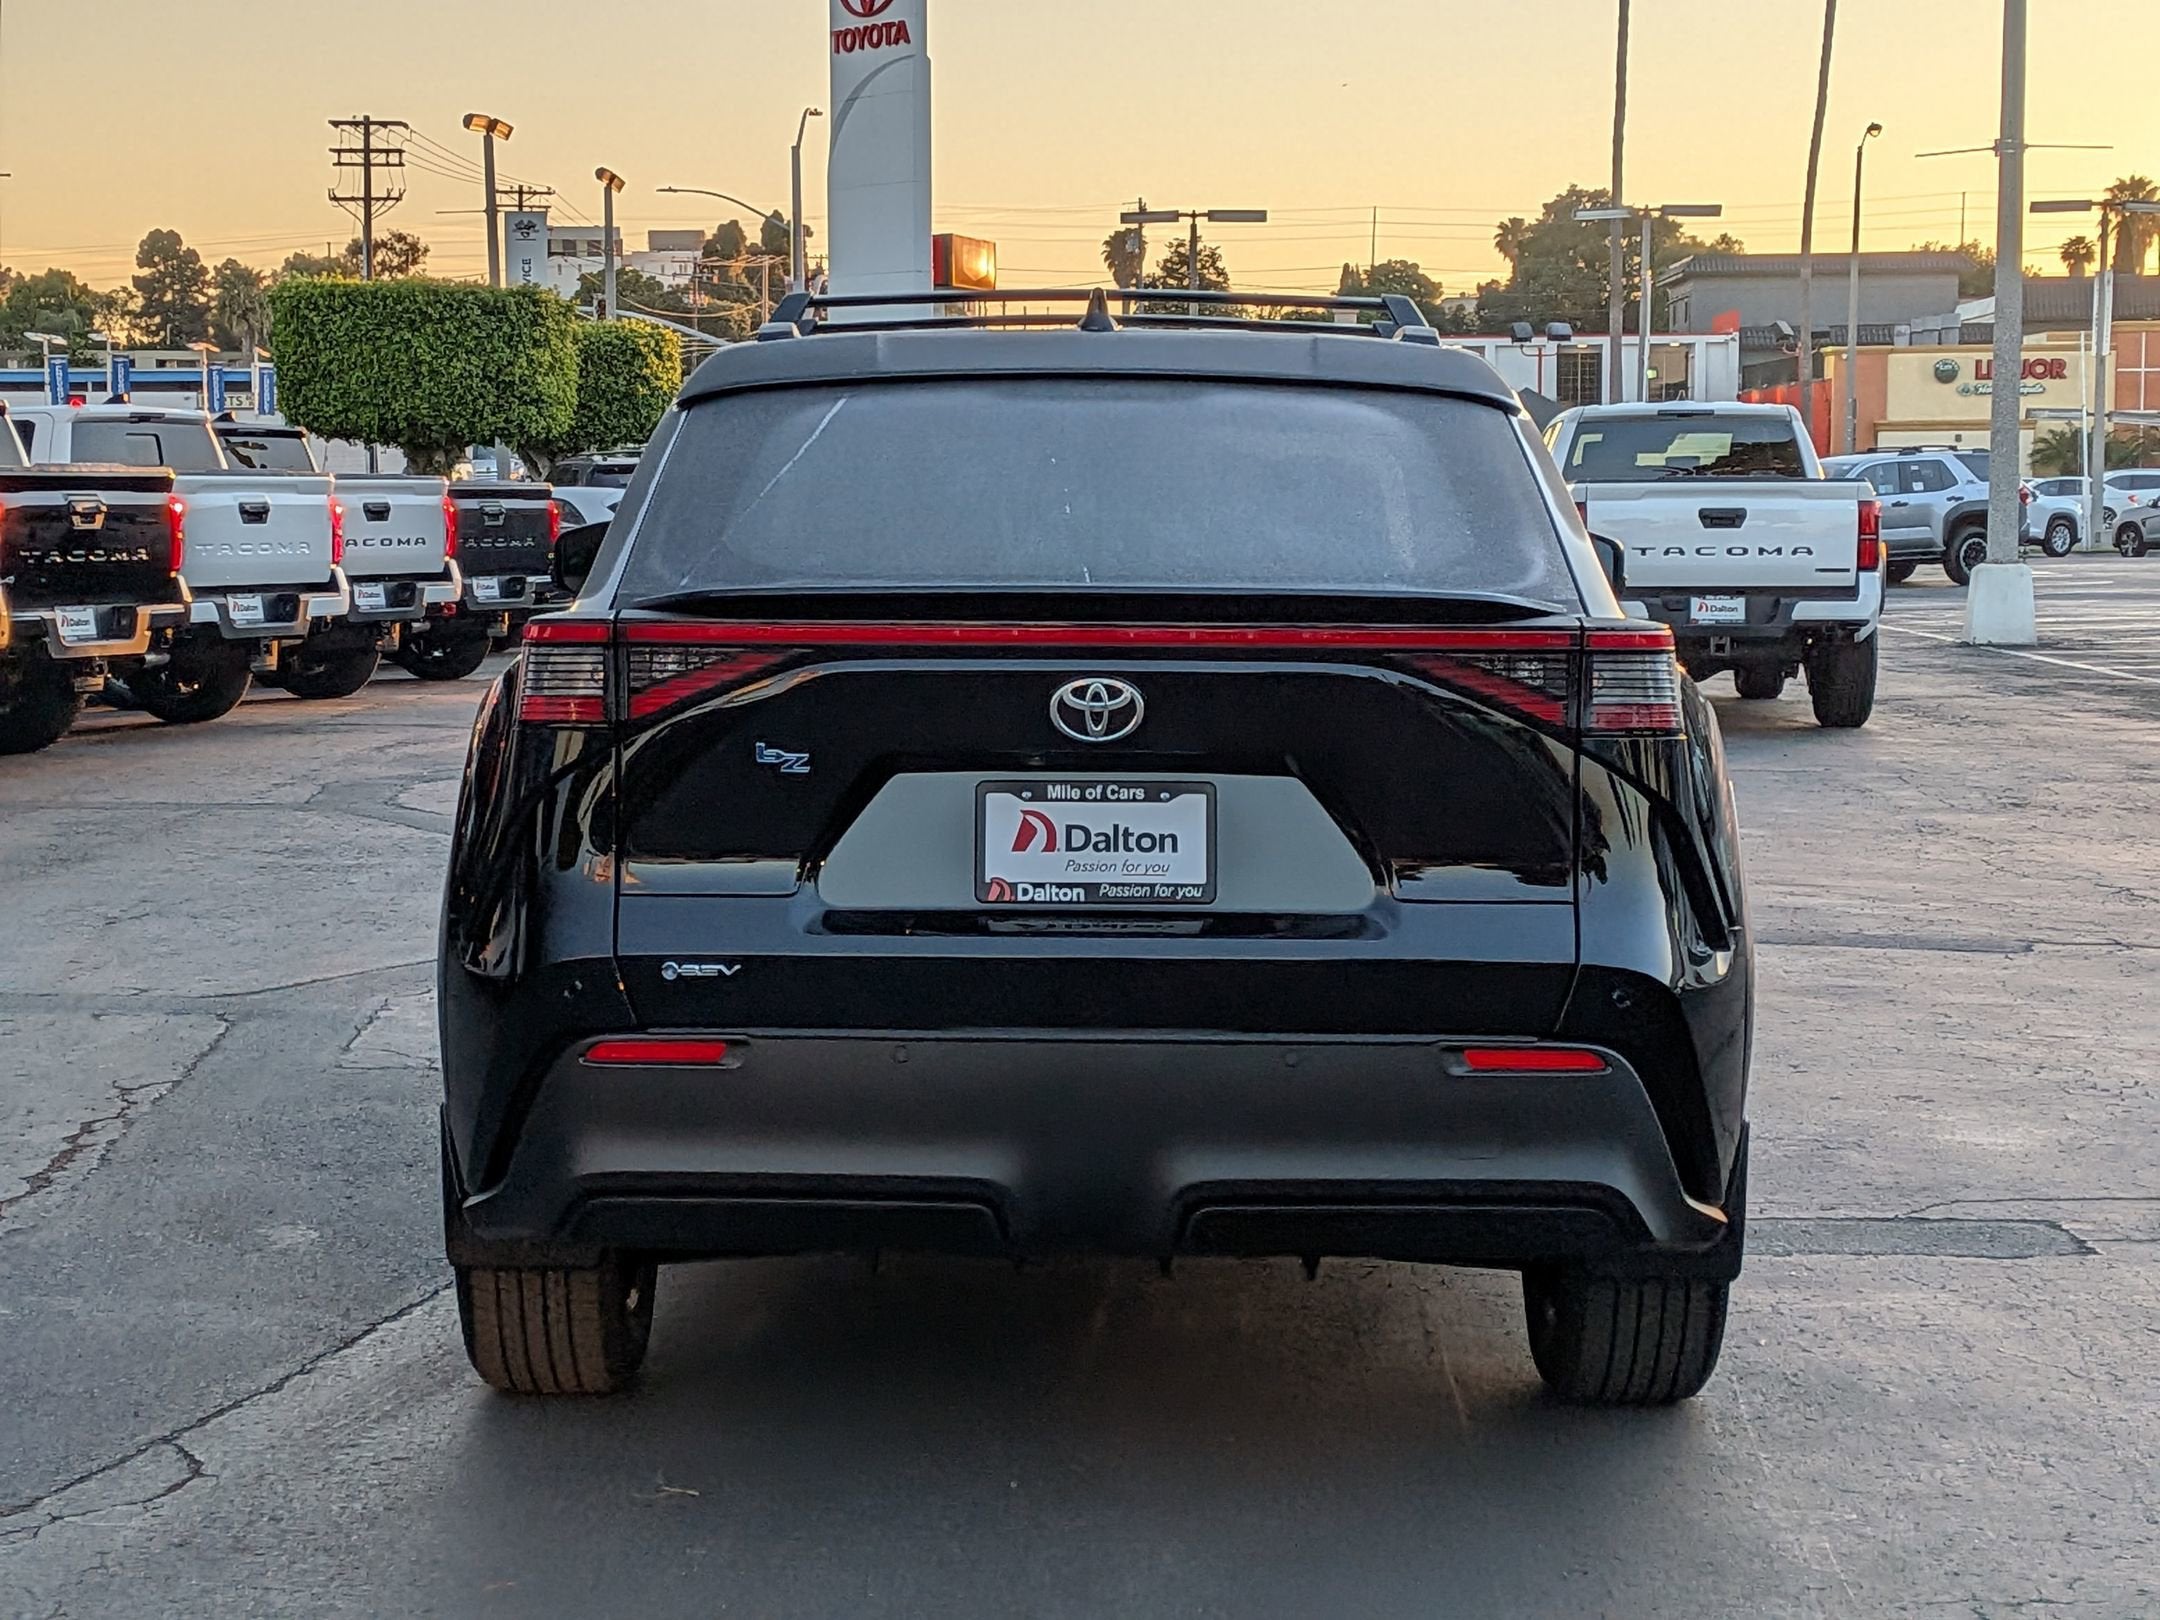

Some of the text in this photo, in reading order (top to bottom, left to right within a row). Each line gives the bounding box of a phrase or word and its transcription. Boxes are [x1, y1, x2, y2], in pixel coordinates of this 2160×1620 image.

[832, 19, 911, 54] TOYOTA
[1974, 358, 2067, 380] LIUOR
[195, 541, 311, 556] TACOMA
[345, 537, 427, 547] ACOMA
[459, 537, 535, 548] ACOMA
[19, 547, 150, 565] TACOMA
[1631, 546, 1815, 557] TACOMA
[1047, 784, 1146, 800] Mile of Cars
[1064, 823, 1179, 853] Dalton
[1065, 859, 1171, 876] Passion for you
[1016, 883, 1203, 902] Dalton Passion for you
